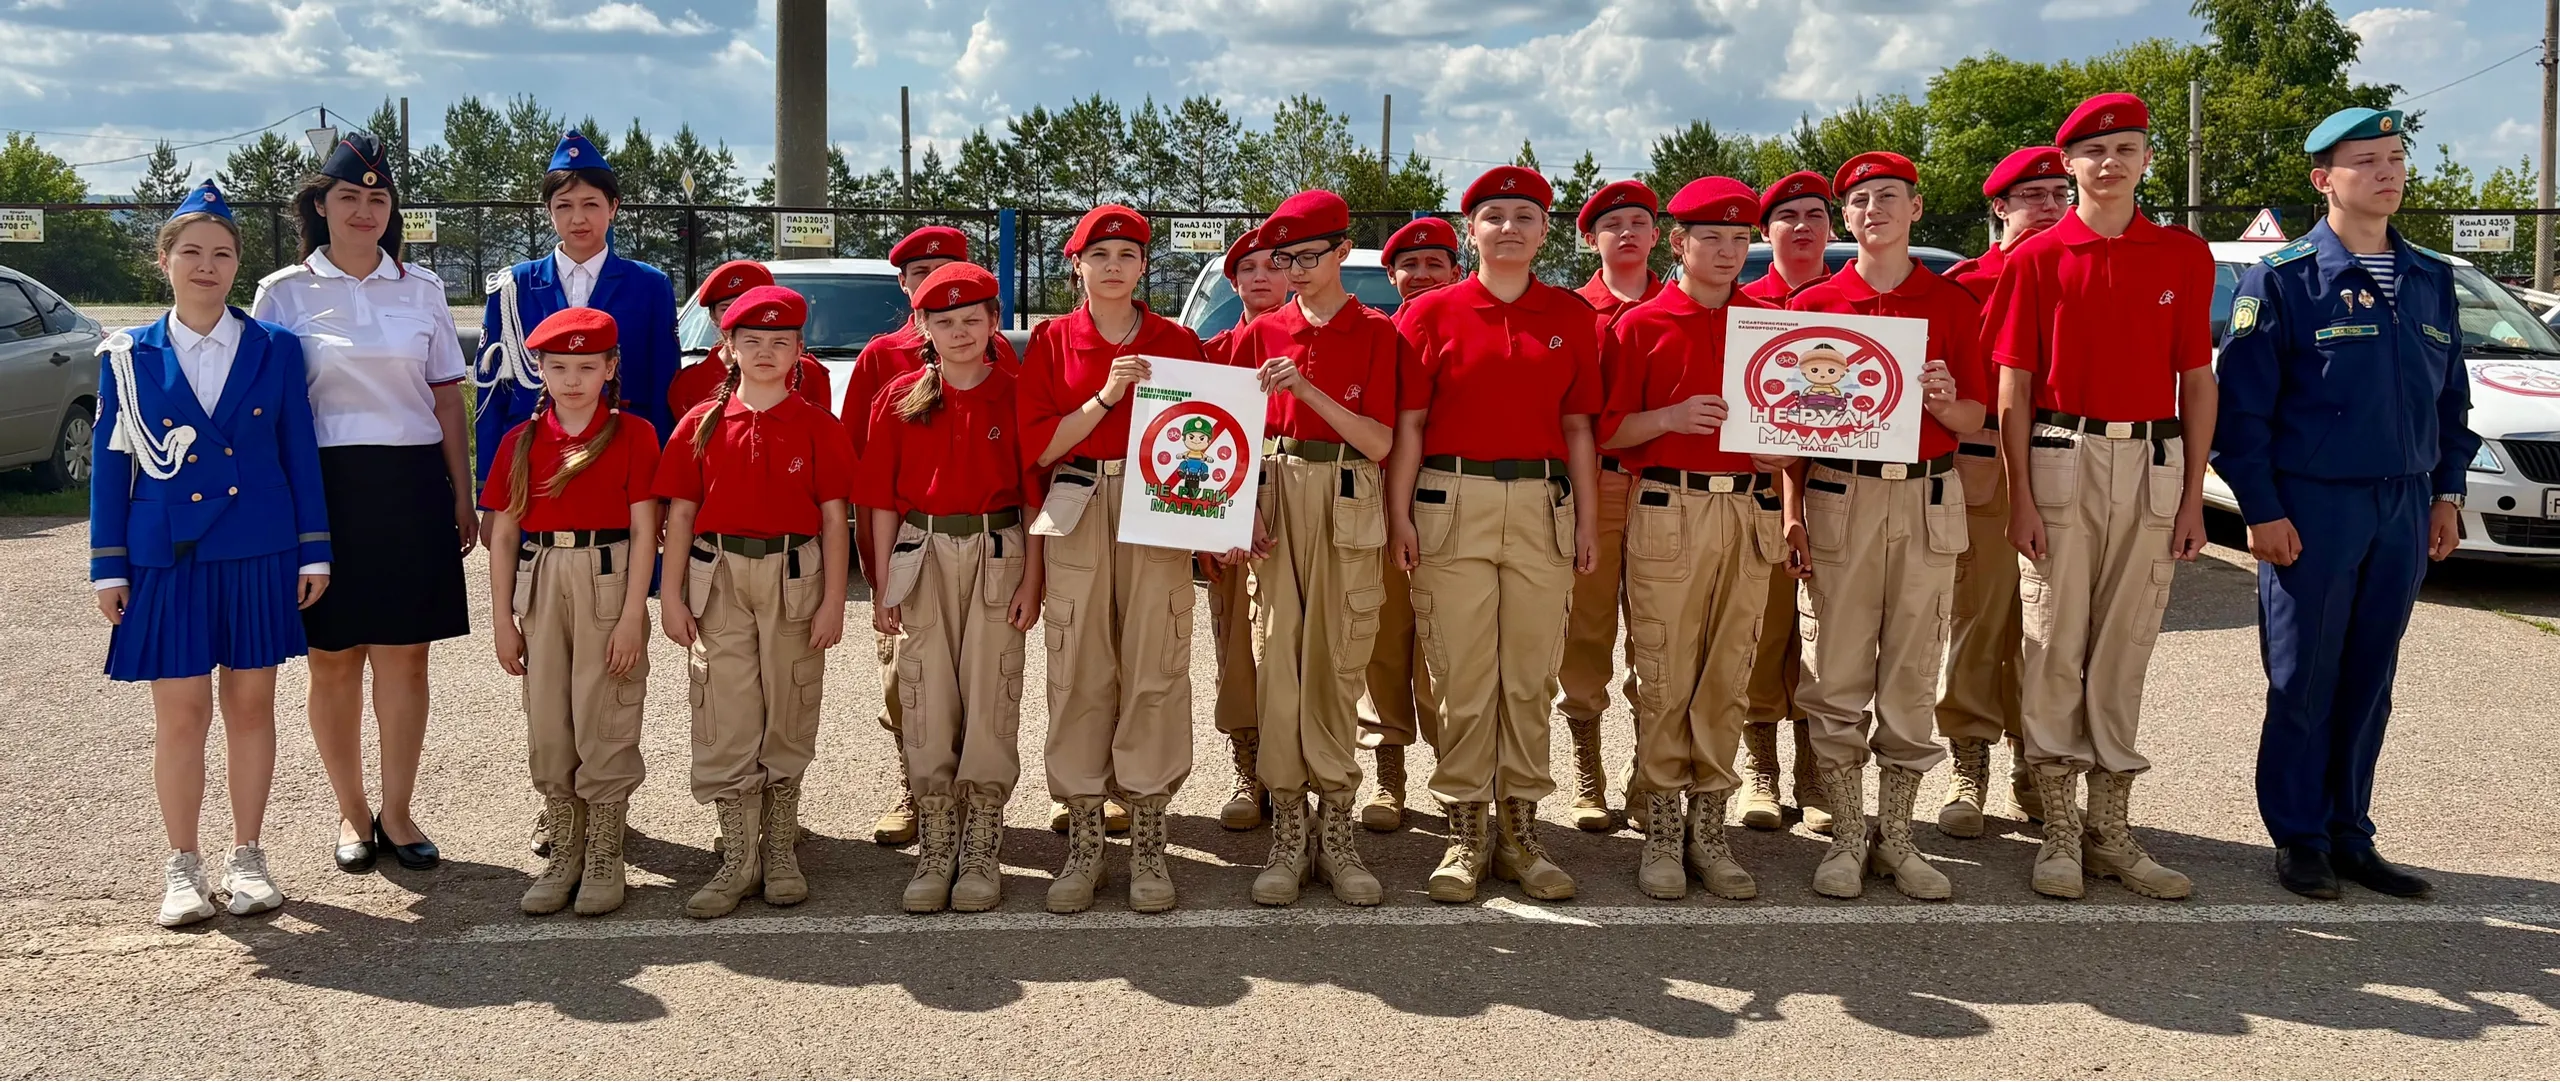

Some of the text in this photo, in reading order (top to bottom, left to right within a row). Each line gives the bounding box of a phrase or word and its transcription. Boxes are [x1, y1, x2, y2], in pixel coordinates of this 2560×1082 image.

[804, 216, 829, 224] 32053
[2489, 218, 2509, 226] 4350
[1174, 221, 1221, 229] КамАЗ 4310
[786, 226, 808, 234] 7393
[2460, 229, 2485, 237] 6216
[2487, 229, 2500, 237] АЕ
[1175, 231, 1197, 239] 7478
[1199, 231, 1212, 239] УН
[1750, 405, 1891, 431] НЕ РУЛИ,
[1758, 426, 1880, 449] МАЛАЙ!
[1145, 482, 1234, 508] НЕ РУЛИ,
[1150, 498, 1226, 520] МАЛАЙ!
